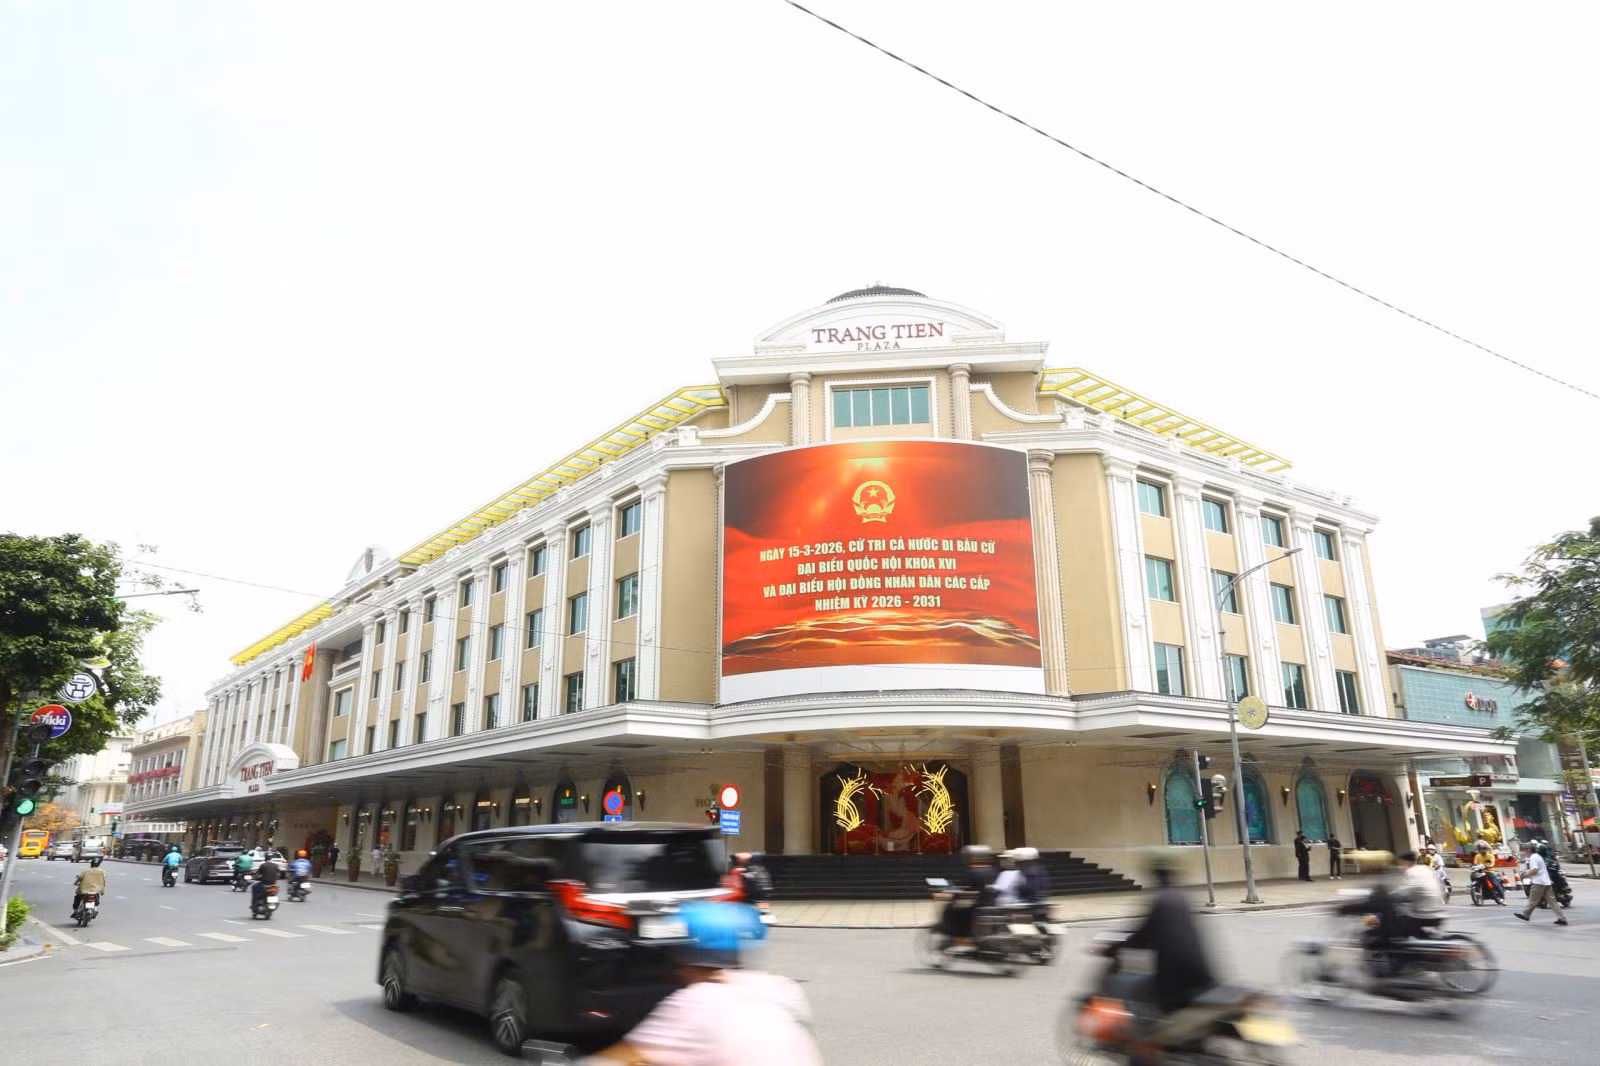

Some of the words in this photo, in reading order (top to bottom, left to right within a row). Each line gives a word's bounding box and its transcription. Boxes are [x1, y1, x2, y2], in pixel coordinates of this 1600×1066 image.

[812, 325, 886, 344] TRANG
[891, 322, 944, 339] TIEN
[857, 341, 900, 351] PLAZA
[868, 540, 886, 551] TRI
[797, 562, 816, 576] ĐẠI
[848, 555, 879, 572] QUỐC
[882, 556, 902, 571] HỘI
[905, 556, 936, 570] KHÓA
[938, 558, 957, 570] XVI
[763, 584, 777, 598] VÀ
[779, 583, 797, 597] ĐẠI
[827, 577, 847, 592] HỘI
[885, 574, 916, 589] NHÂN
[919, 574, 942, 589] DÂN
[944, 575, 967, 589] CÁC
[815, 596, 850, 612] NHIỆM
[871, 595, 902, 608] 2026
[913, 595, 941, 608] 2031
[1479, 777, 1486, 785] P
